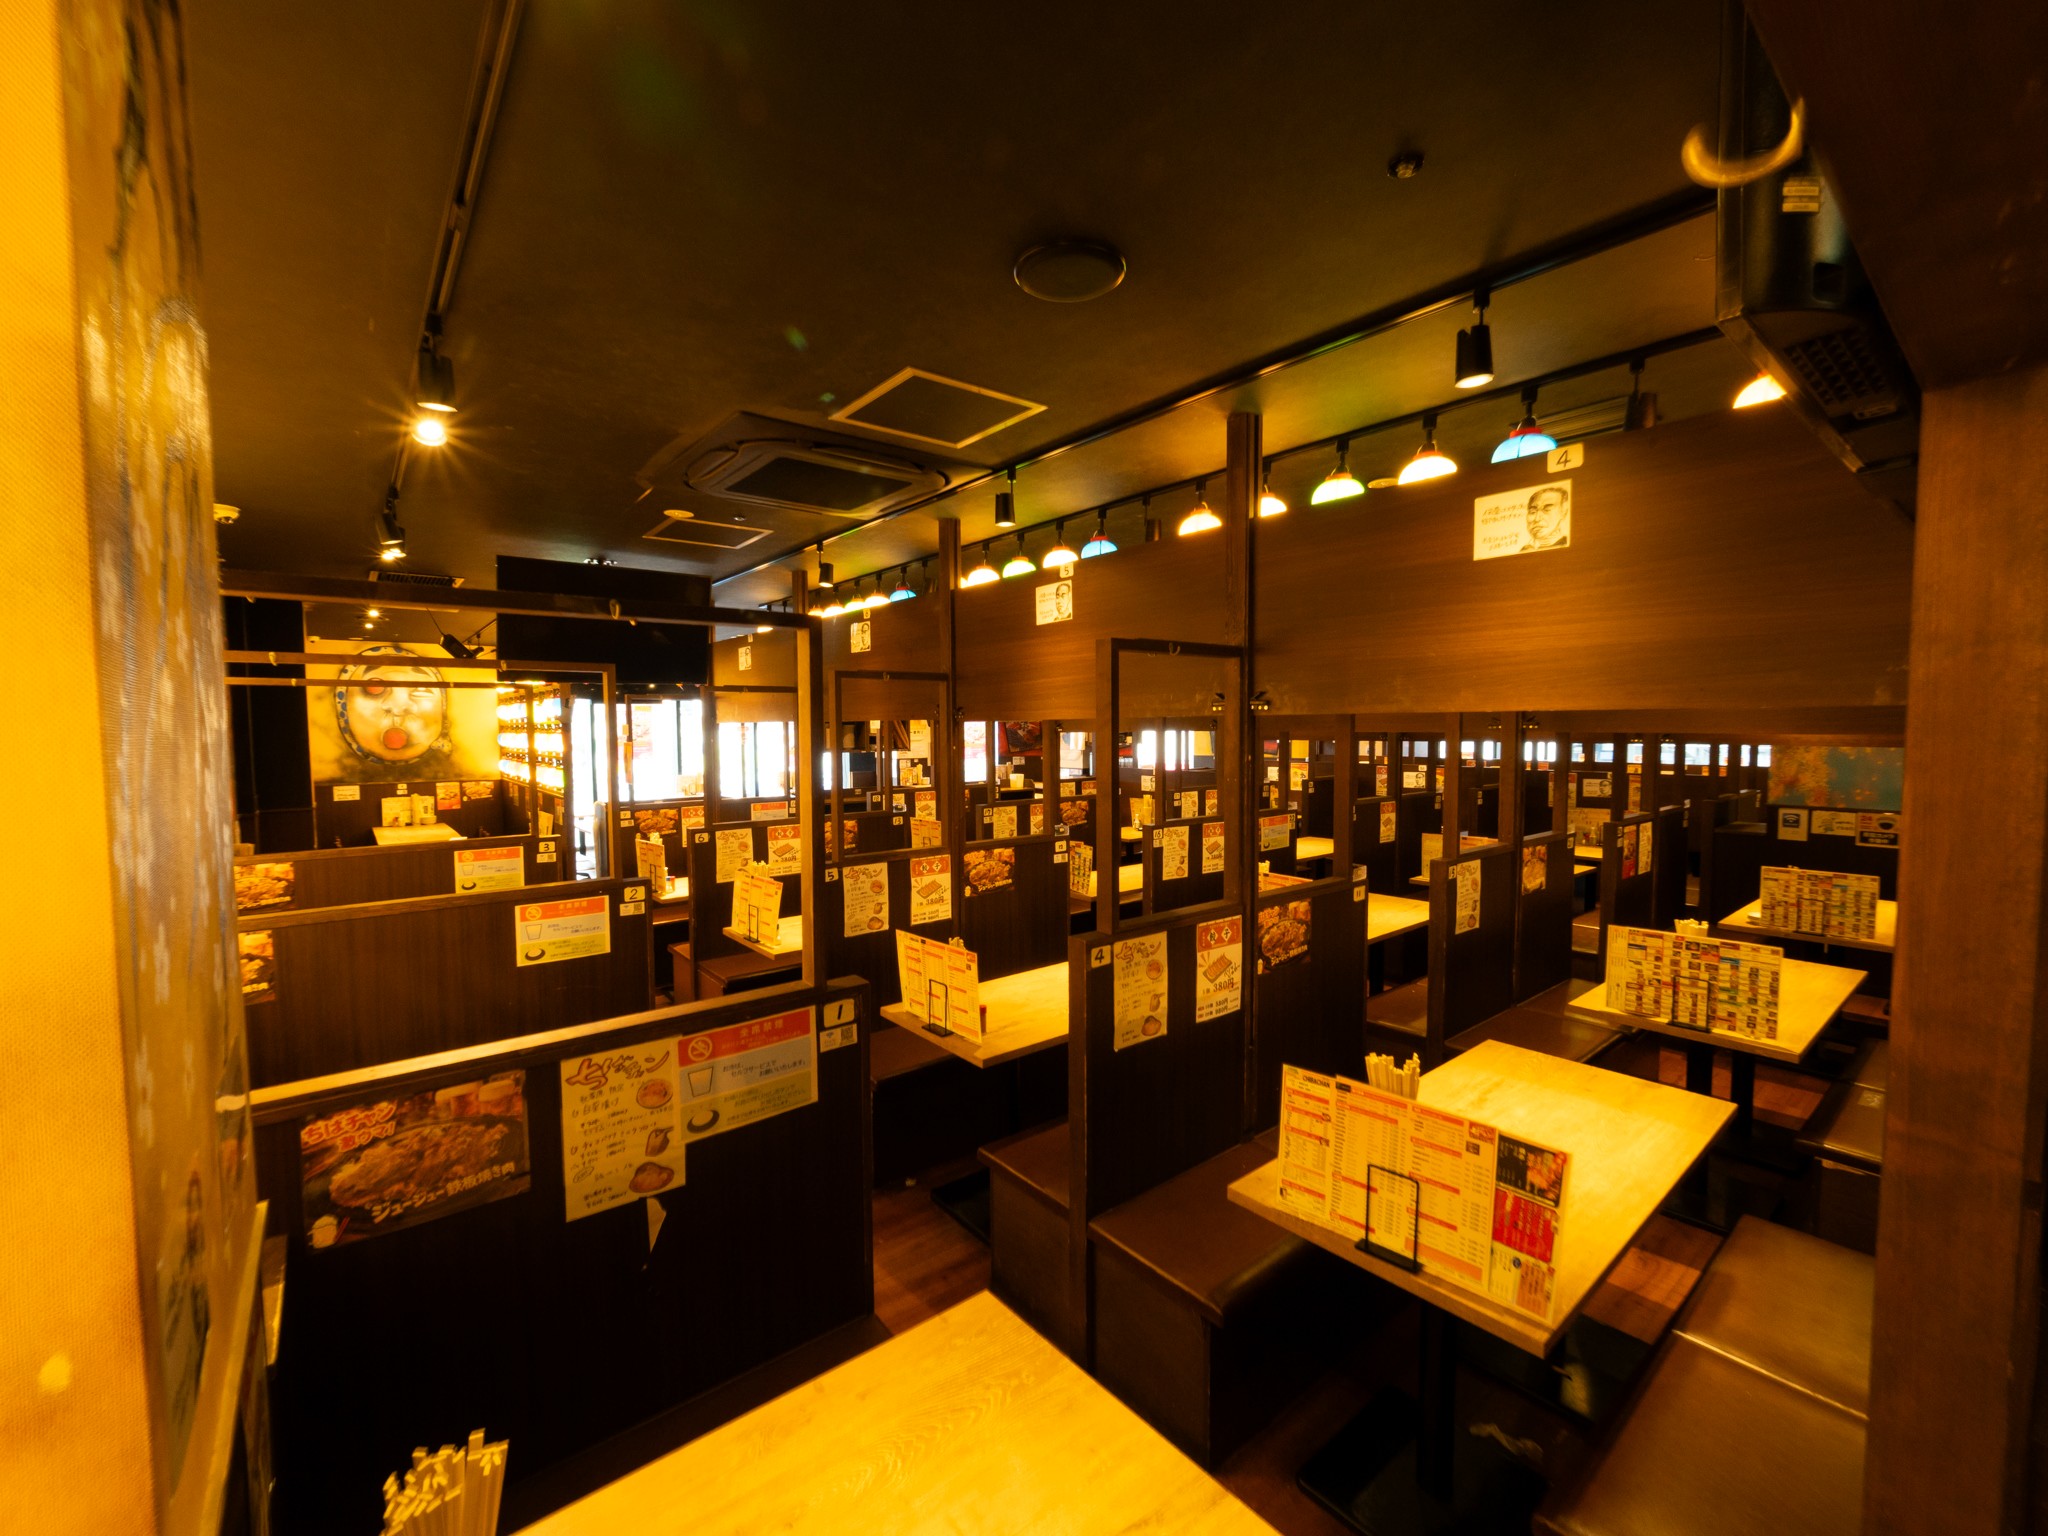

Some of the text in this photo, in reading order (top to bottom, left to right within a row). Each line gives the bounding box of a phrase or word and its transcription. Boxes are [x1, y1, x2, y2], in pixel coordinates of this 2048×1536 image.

[1555, 449, 1572, 468] 4
[697, 834, 705, 843] 6
[543, 843, 550, 852] 3
[827, 869, 835, 881] 5
[629, 888, 638, 900] 2
[1094, 947, 1105, 963] 4
[1213, 977, 1235, 993] 380円
[837, 1004, 844, 1021] 1
